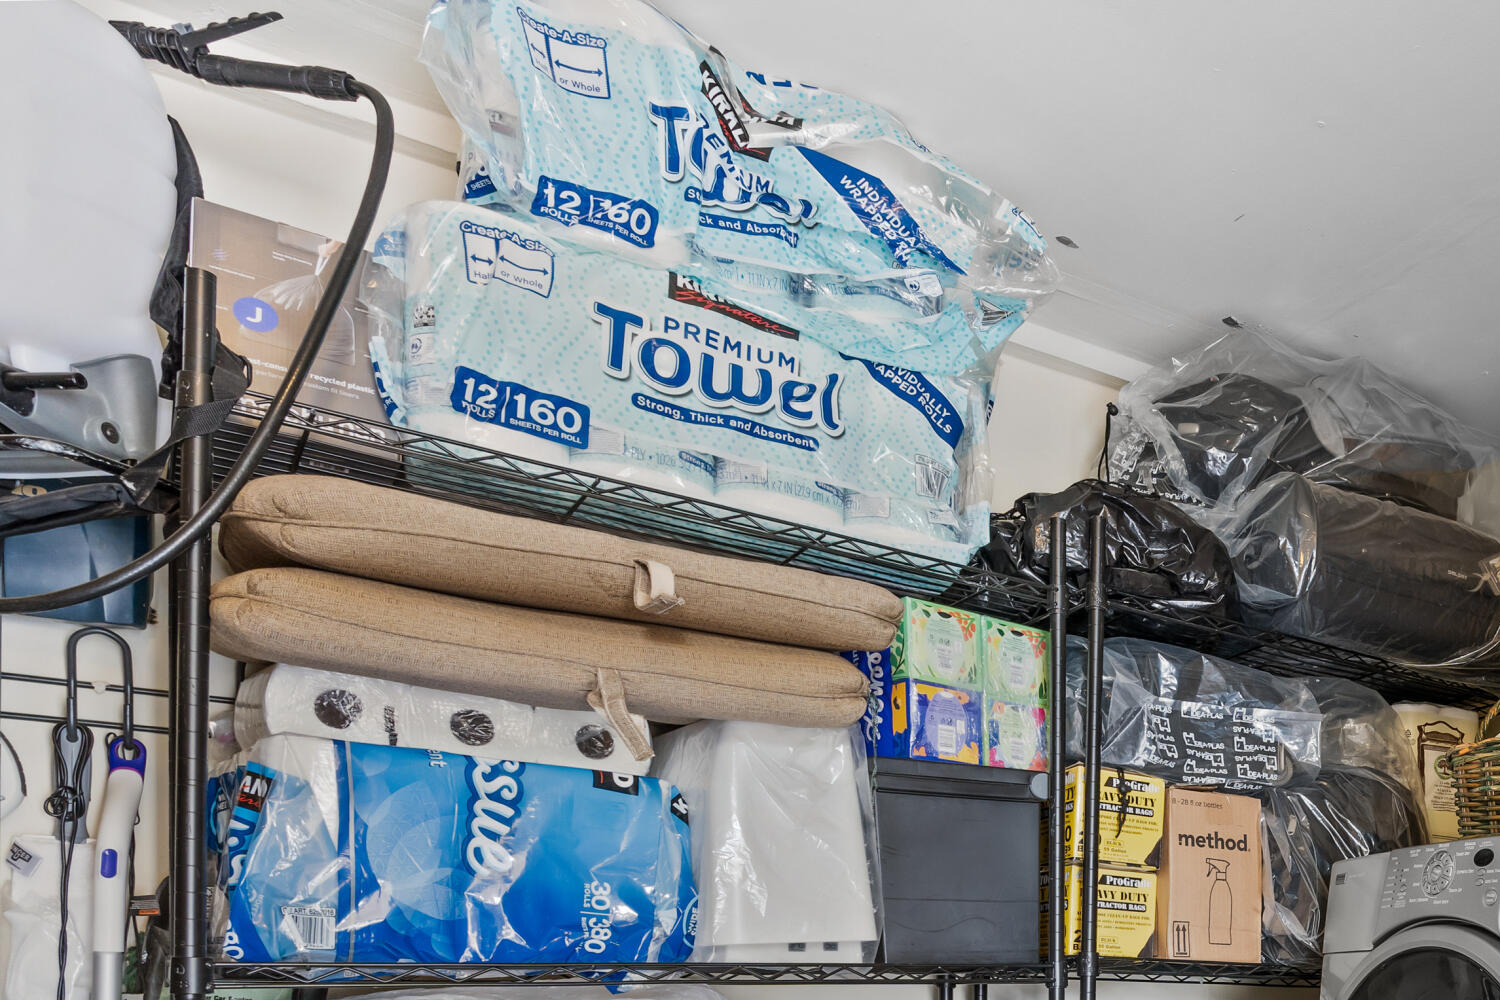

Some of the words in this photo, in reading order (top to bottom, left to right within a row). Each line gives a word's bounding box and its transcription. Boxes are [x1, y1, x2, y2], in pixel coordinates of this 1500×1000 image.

[571, 79, 601, 93] Whole
[543, 181, 582, 215] 12
[615, 225, 629, 236] PER
[630, 233, 649, 246] ROLL
[718, 218, 741, 231] and
[513, 273, 544, 290] Whole
[246, 306, 263, 324] J
[663, 314, 797, 375] PREMIUM
[592, 300, 844, 432] Towel
[310, 373, 346, 388] recycled
[347, 382, 376, 396] plastic
[463, 377, 498, 409] 12
[874, 362, 918, 396] APPED
[917, 395, 953, 435] ROLLS
[513, 392, 583, 435] 160
[636, 395, 685, 420] Strong,
[689, 411, 725, 425] Thick
[729, 418, 752, 432] and
[752, 425, 817, 450] Absorbent
[509, 417, 542, 432] SHEETS
[543, 426, 559, 438] PER
[560, 433, 583, 445] ROLL
[1127, 794, 1156, 807] DUTY
[1135, 807, 1154, 817] BAGS
[582, 882, 591, 908] ROLLS
[591, 880, 612, 911] 30
[1097, 900, 1127, 910] TRACTOR
[1128, 903, 1147, 912] BAGS
[1120, 890, 1149, 903] DUTY
[584, 915, 613, 955] 380
